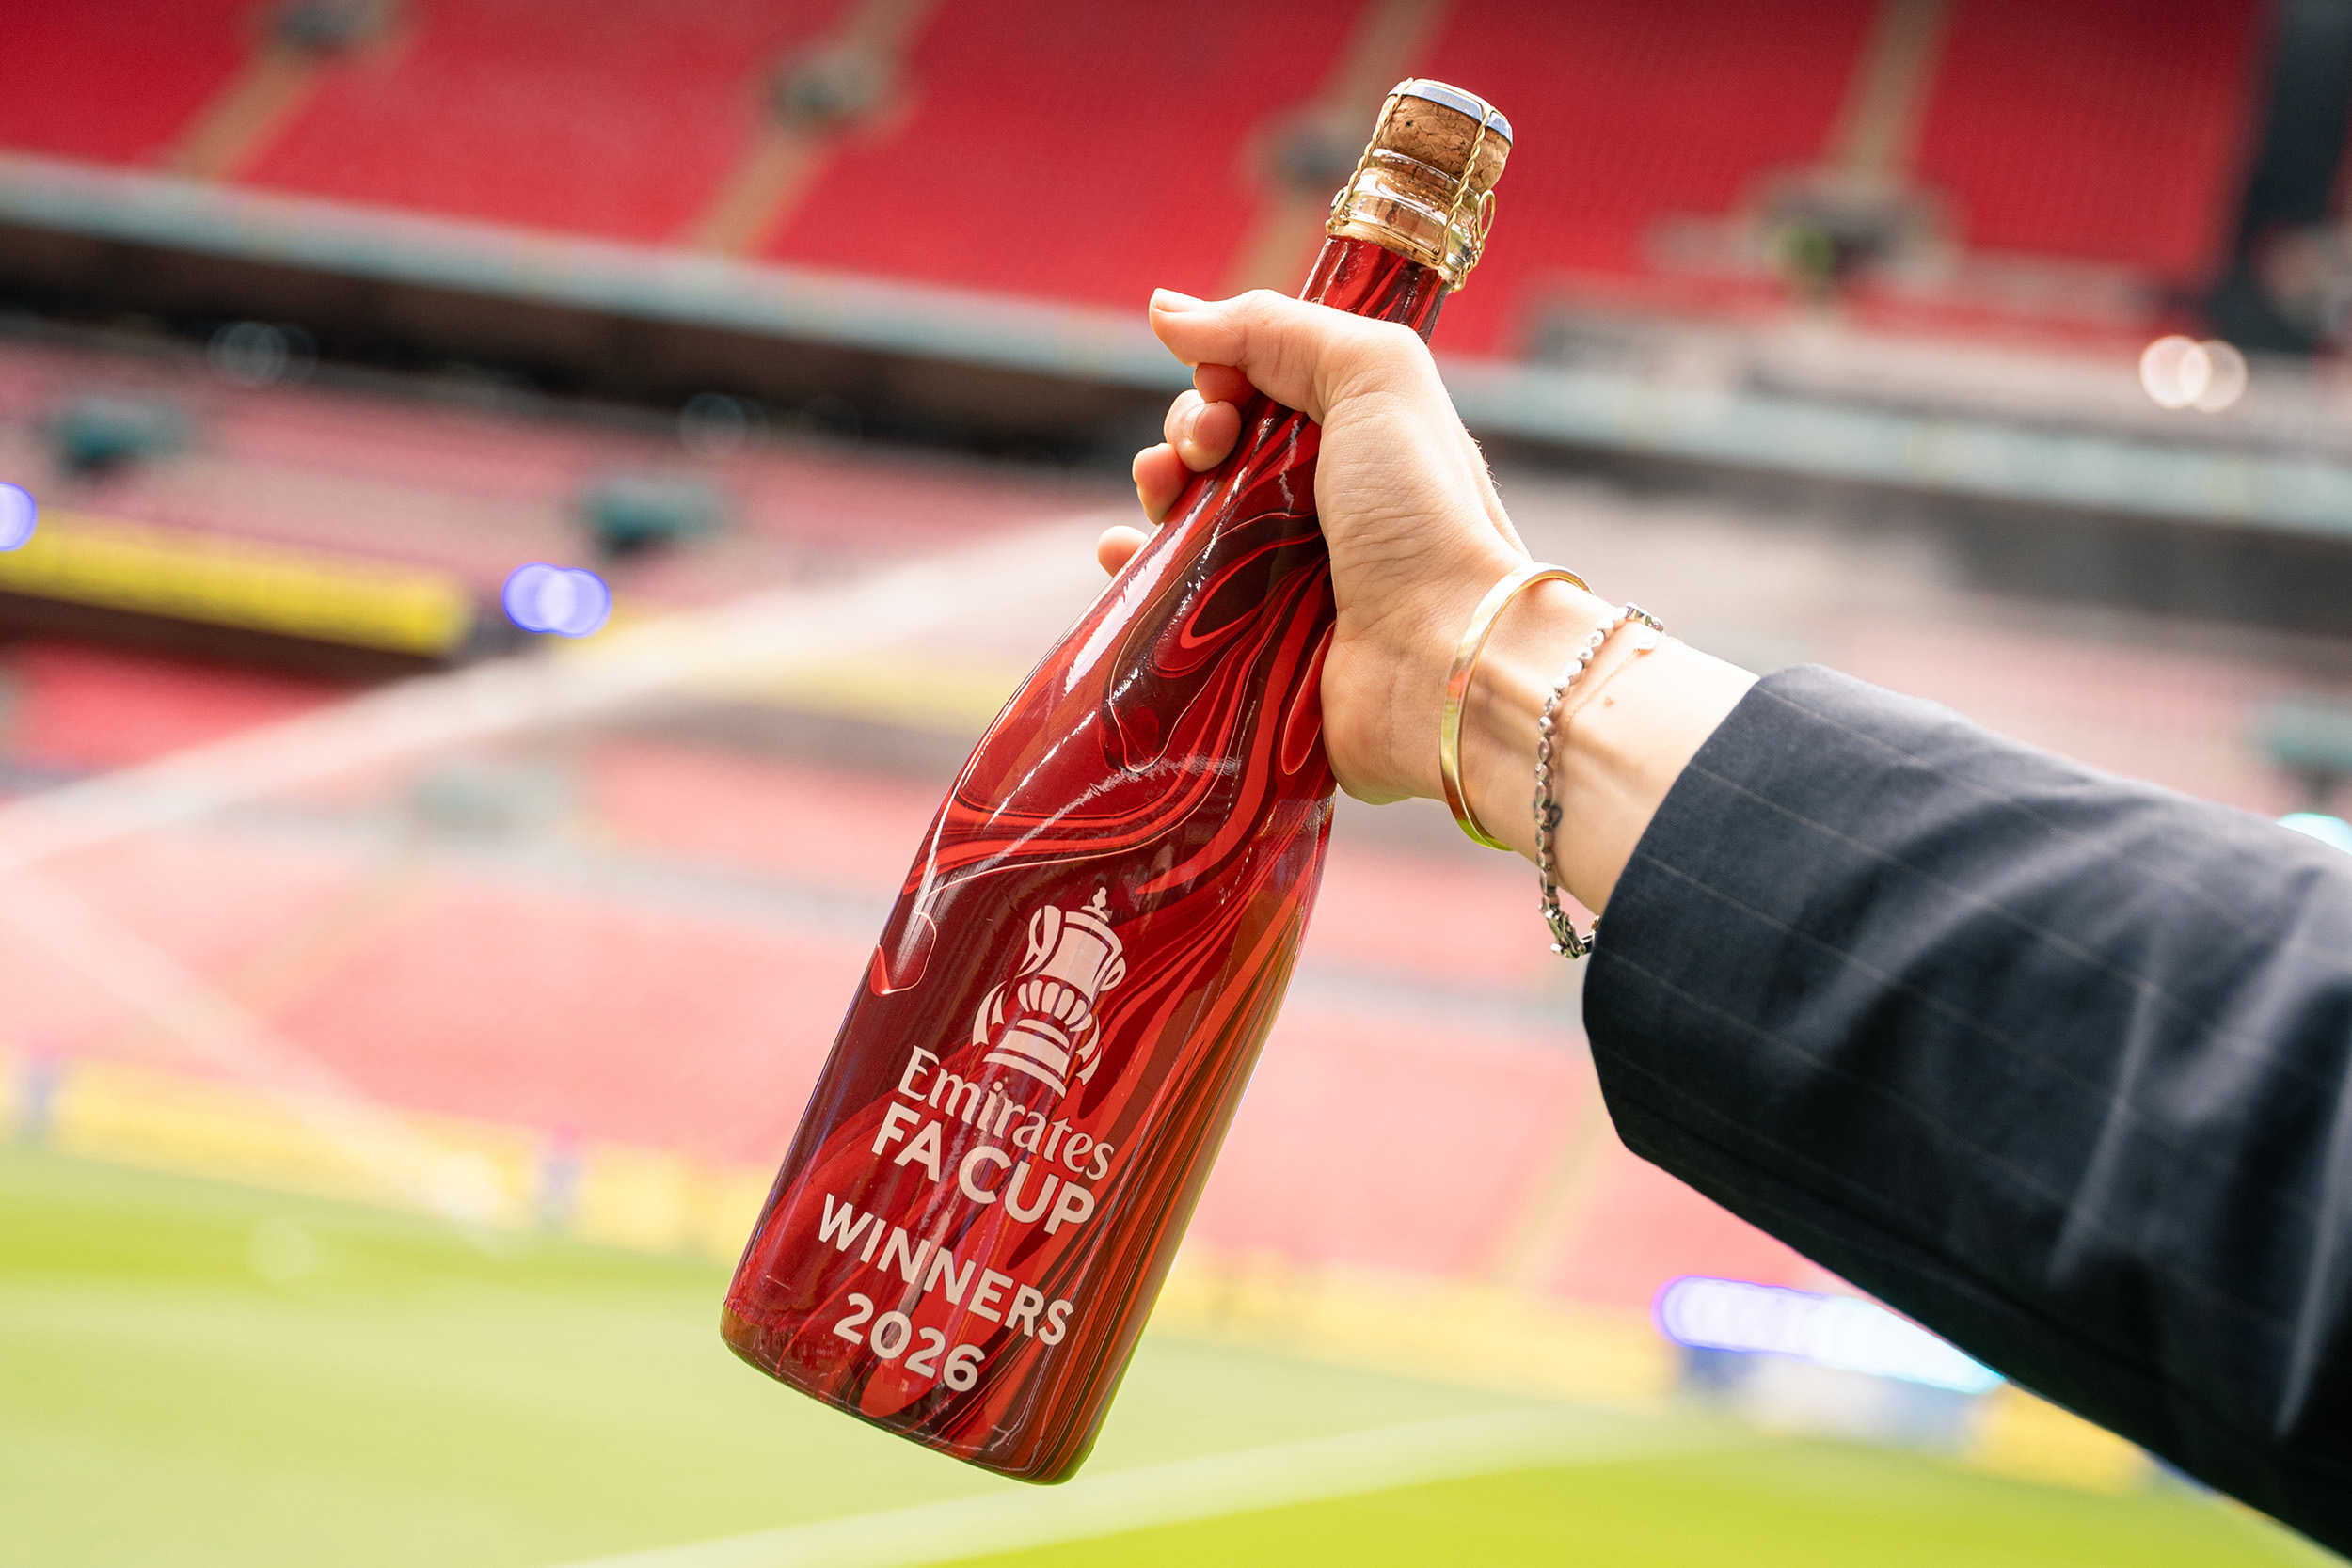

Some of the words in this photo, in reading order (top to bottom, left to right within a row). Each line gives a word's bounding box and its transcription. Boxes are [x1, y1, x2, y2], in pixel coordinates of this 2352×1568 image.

[871, 1101, 942, 1183] FA
[958, 1144, 1096, 1235] CUP
[898, 1044, 1115, 1181] Emirates
[818, 1192, 1074, 1347] WINNERS
[833, 1292, 986, 1392] 2026
